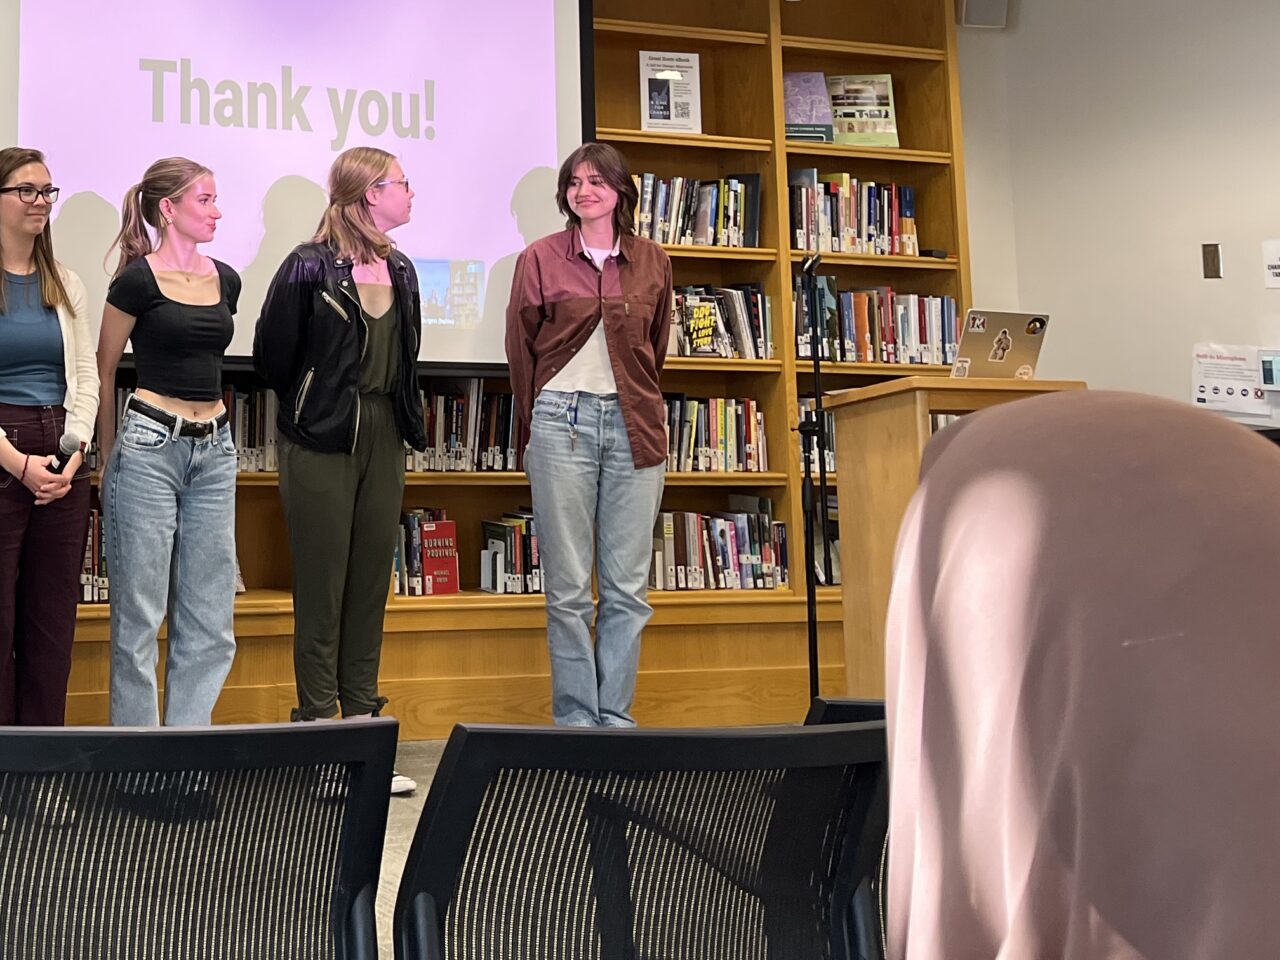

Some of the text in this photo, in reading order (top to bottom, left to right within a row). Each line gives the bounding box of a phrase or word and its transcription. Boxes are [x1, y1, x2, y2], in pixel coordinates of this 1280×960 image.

[139, 58, 436, 152] Thank you!
[693, 306, 711, 319] DOG
[692, 327, 713, 339] A LOVE
[693, 336, 712, 348] STORY
[424, 538, 454, 548] BURNING
